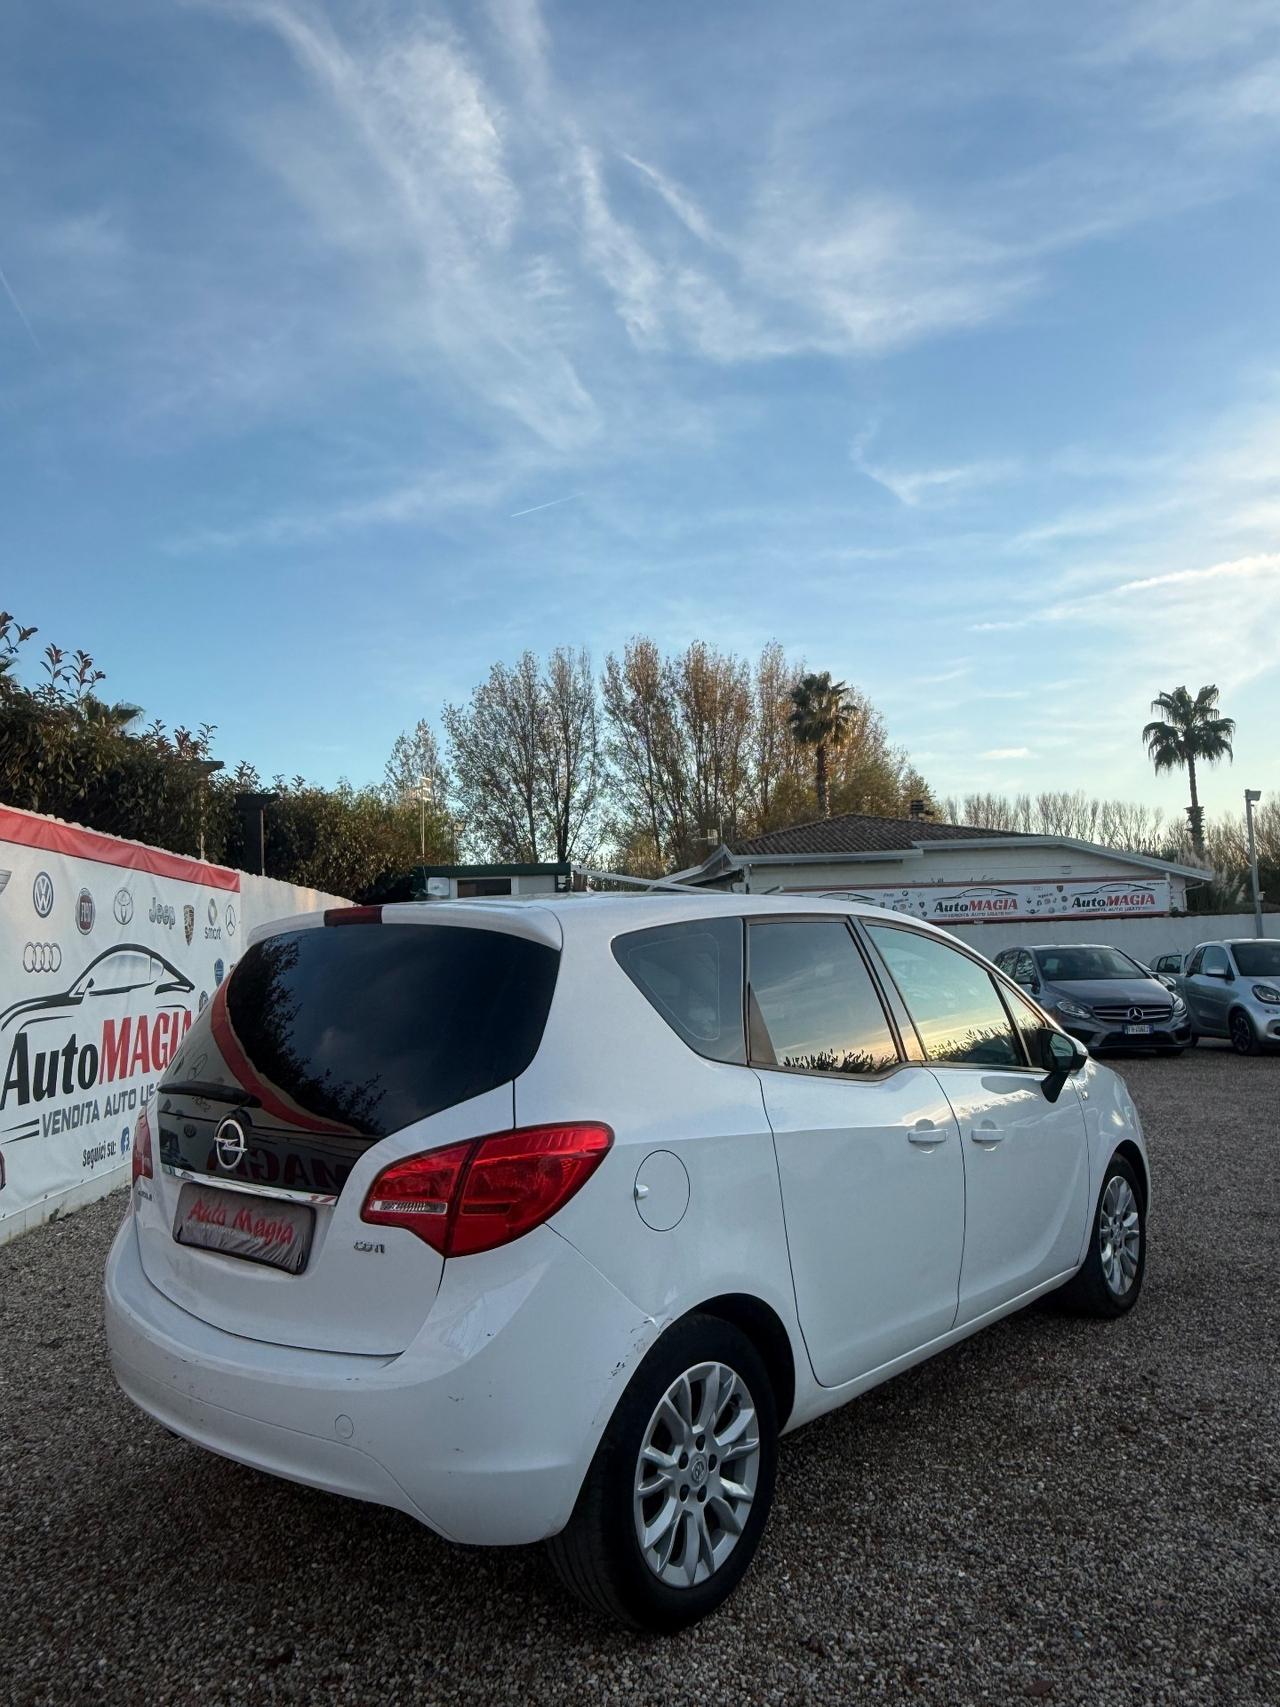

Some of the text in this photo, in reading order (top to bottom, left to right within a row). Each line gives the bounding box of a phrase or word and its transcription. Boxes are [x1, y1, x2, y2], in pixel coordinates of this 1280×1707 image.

[148, 896, 176, 930] Jeep
[934, 898, 1019, 913] AutoMAGIA
[1071, 893, 1156, 909] AutoMAGIA
[42, 1099, 101, 1138] VENDITA
[104, 1089, 137, 1119] AUTO
[82, 1141, 107, 1170] Seguici
[188, 1199, 226, 1226] Auto
[233, 1207, 295, 1246] Magia
